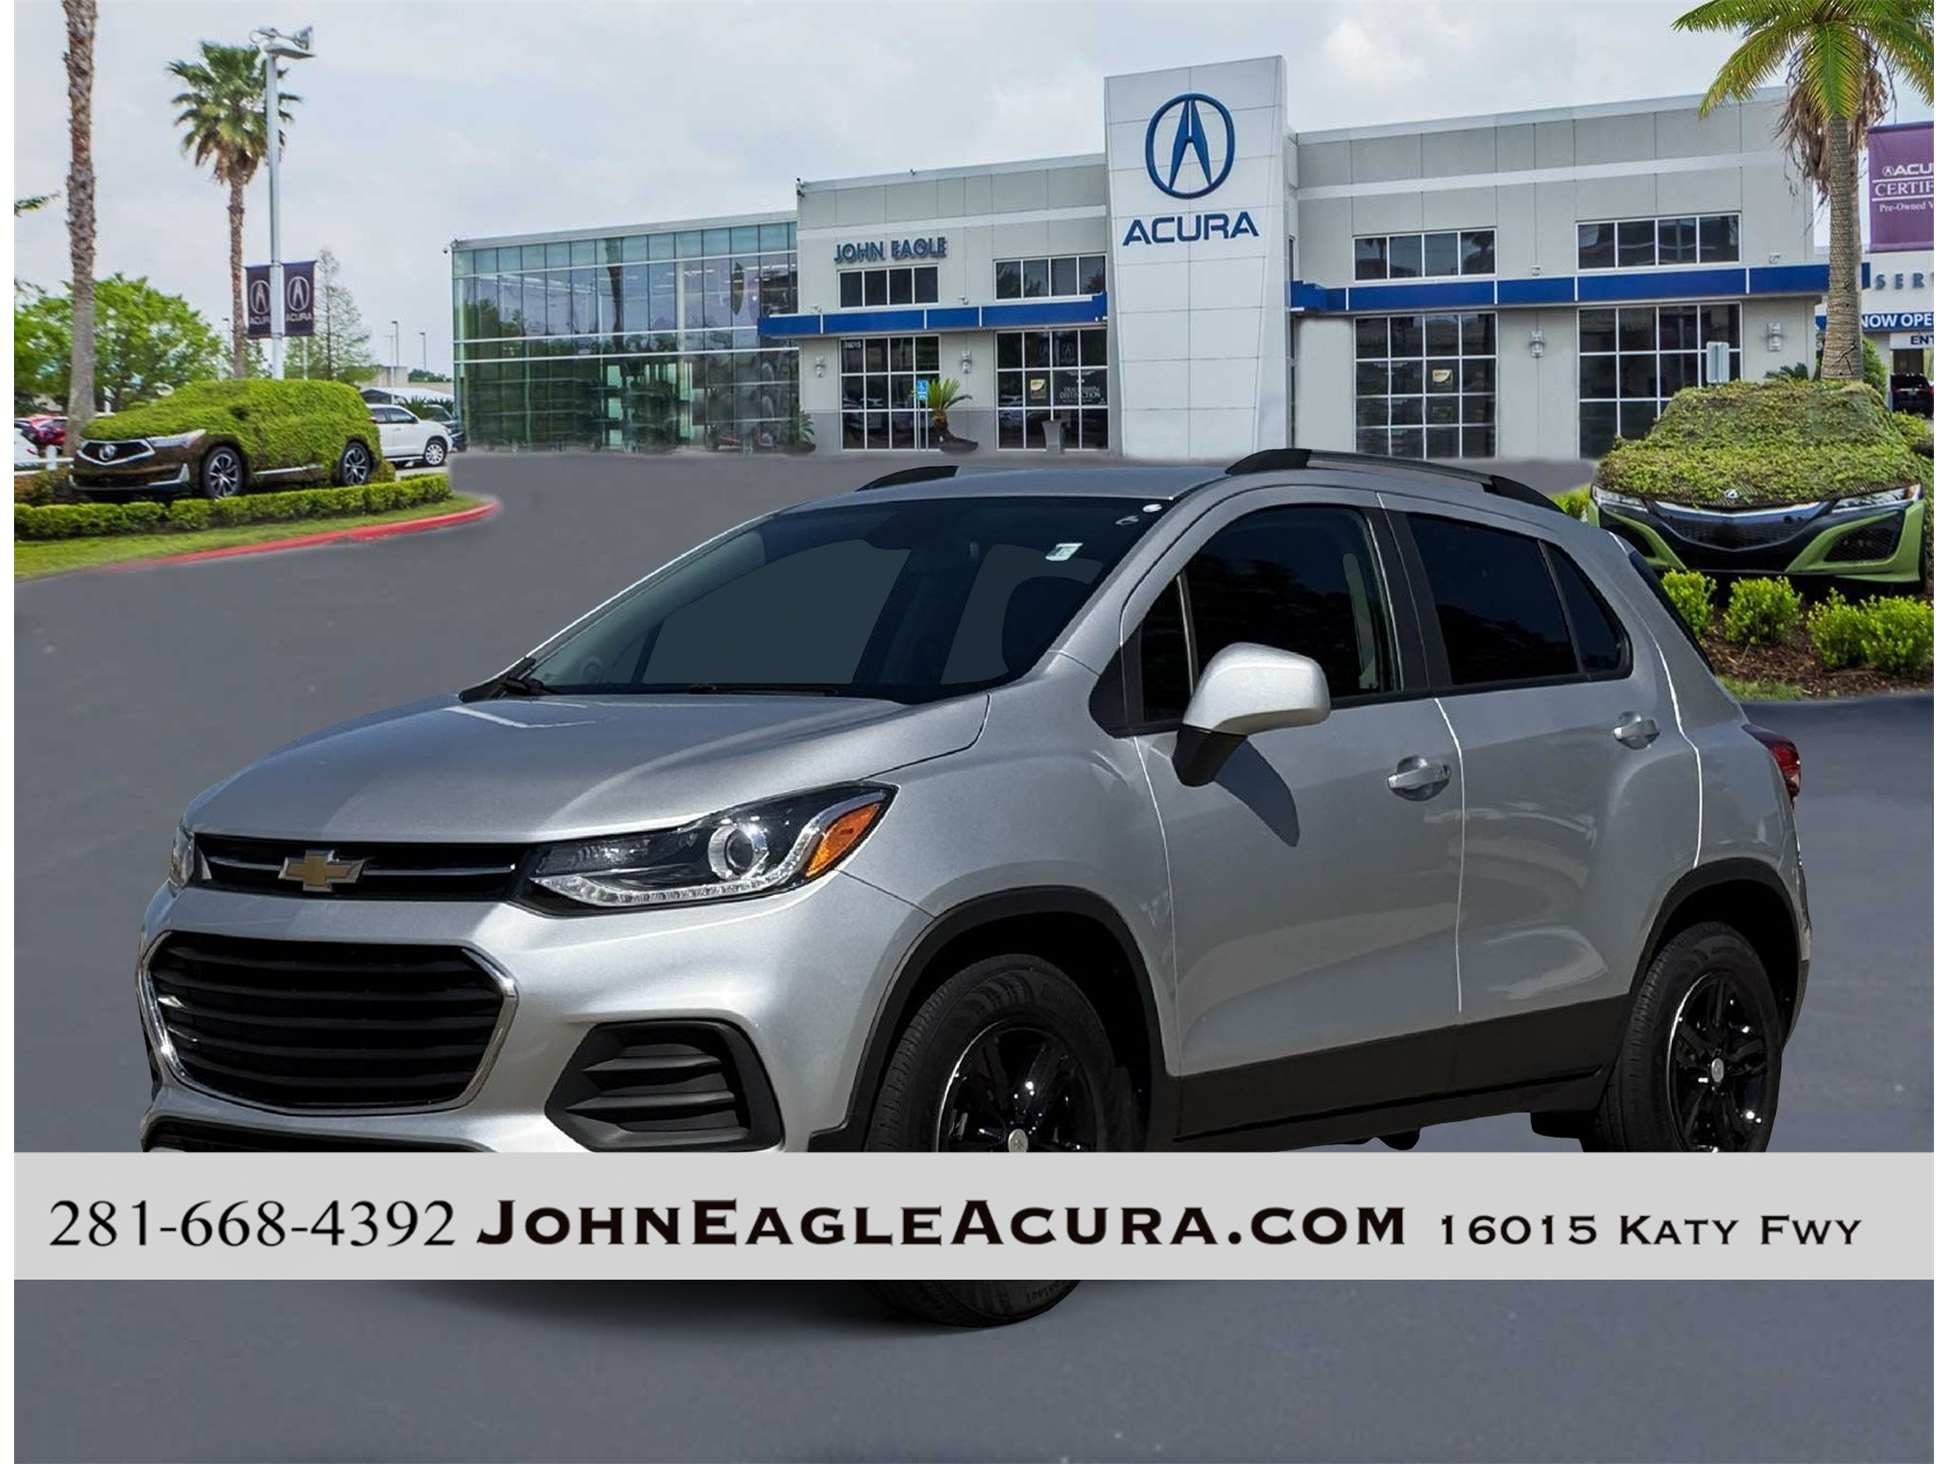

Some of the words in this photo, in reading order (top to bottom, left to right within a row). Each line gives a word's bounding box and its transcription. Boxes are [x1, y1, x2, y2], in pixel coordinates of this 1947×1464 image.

[1894, 163, 1935, 176] ACU
[1123, 211, 1259, 246] ACURA
[834, 241, 885, 262] JOHN
[891, 237, 947, 259] EAGLE
[1875, 271, 1934, 290] SER
[1861, 314, 1898, 328] NOW
[1901, 313, 1934, 327] OPE
